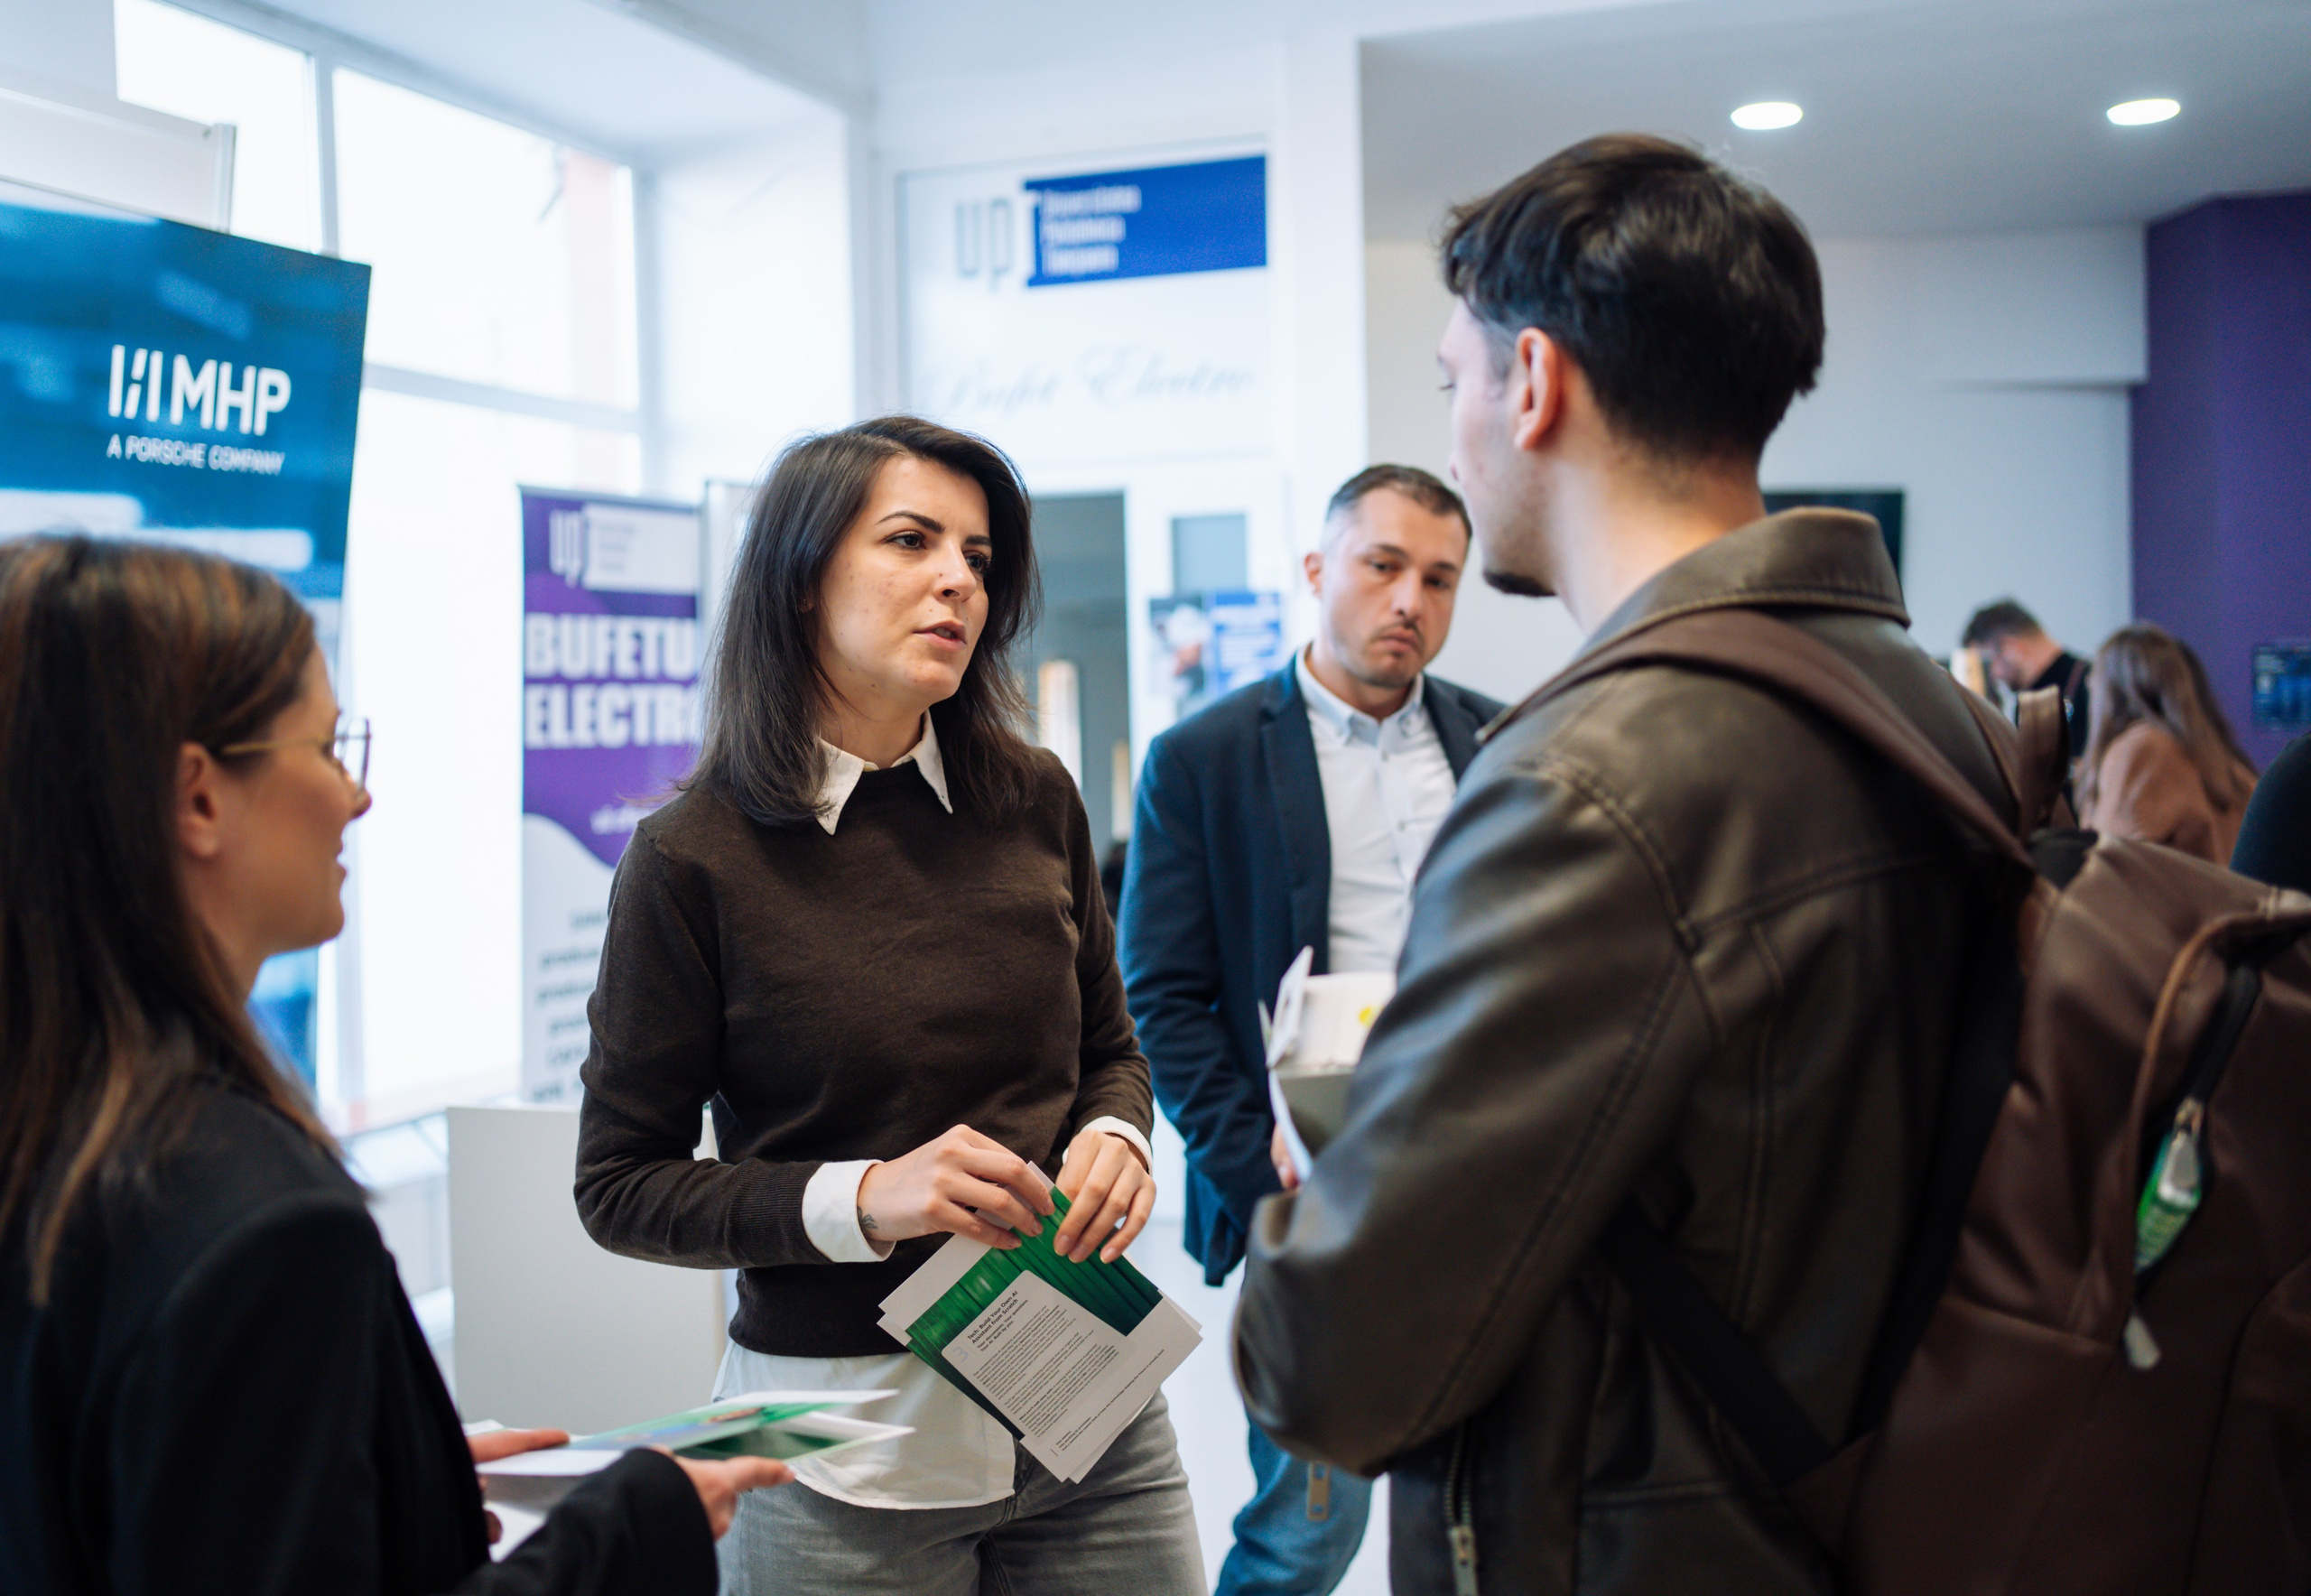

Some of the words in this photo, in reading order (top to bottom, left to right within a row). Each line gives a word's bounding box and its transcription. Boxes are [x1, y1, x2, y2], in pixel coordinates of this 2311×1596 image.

[170, 354, 292, 436] MHP
[107, 434, 122, 459] A
[125, 435, 207, 469] PORSCHE
[209, 445, 284, 476] COMPANY
[967, 1327, 979, 1340] Tech:
[978, 1316, 991, 1329] Build
[989, 1306, 1002, 1317] Your
[999, 1295, 1012, 1307] Own
[970, 1323, 992, 1344] Assistant
[990, 1313, 1003, 1324] from
[1001, 1298, 1018, 1314] Scratch
